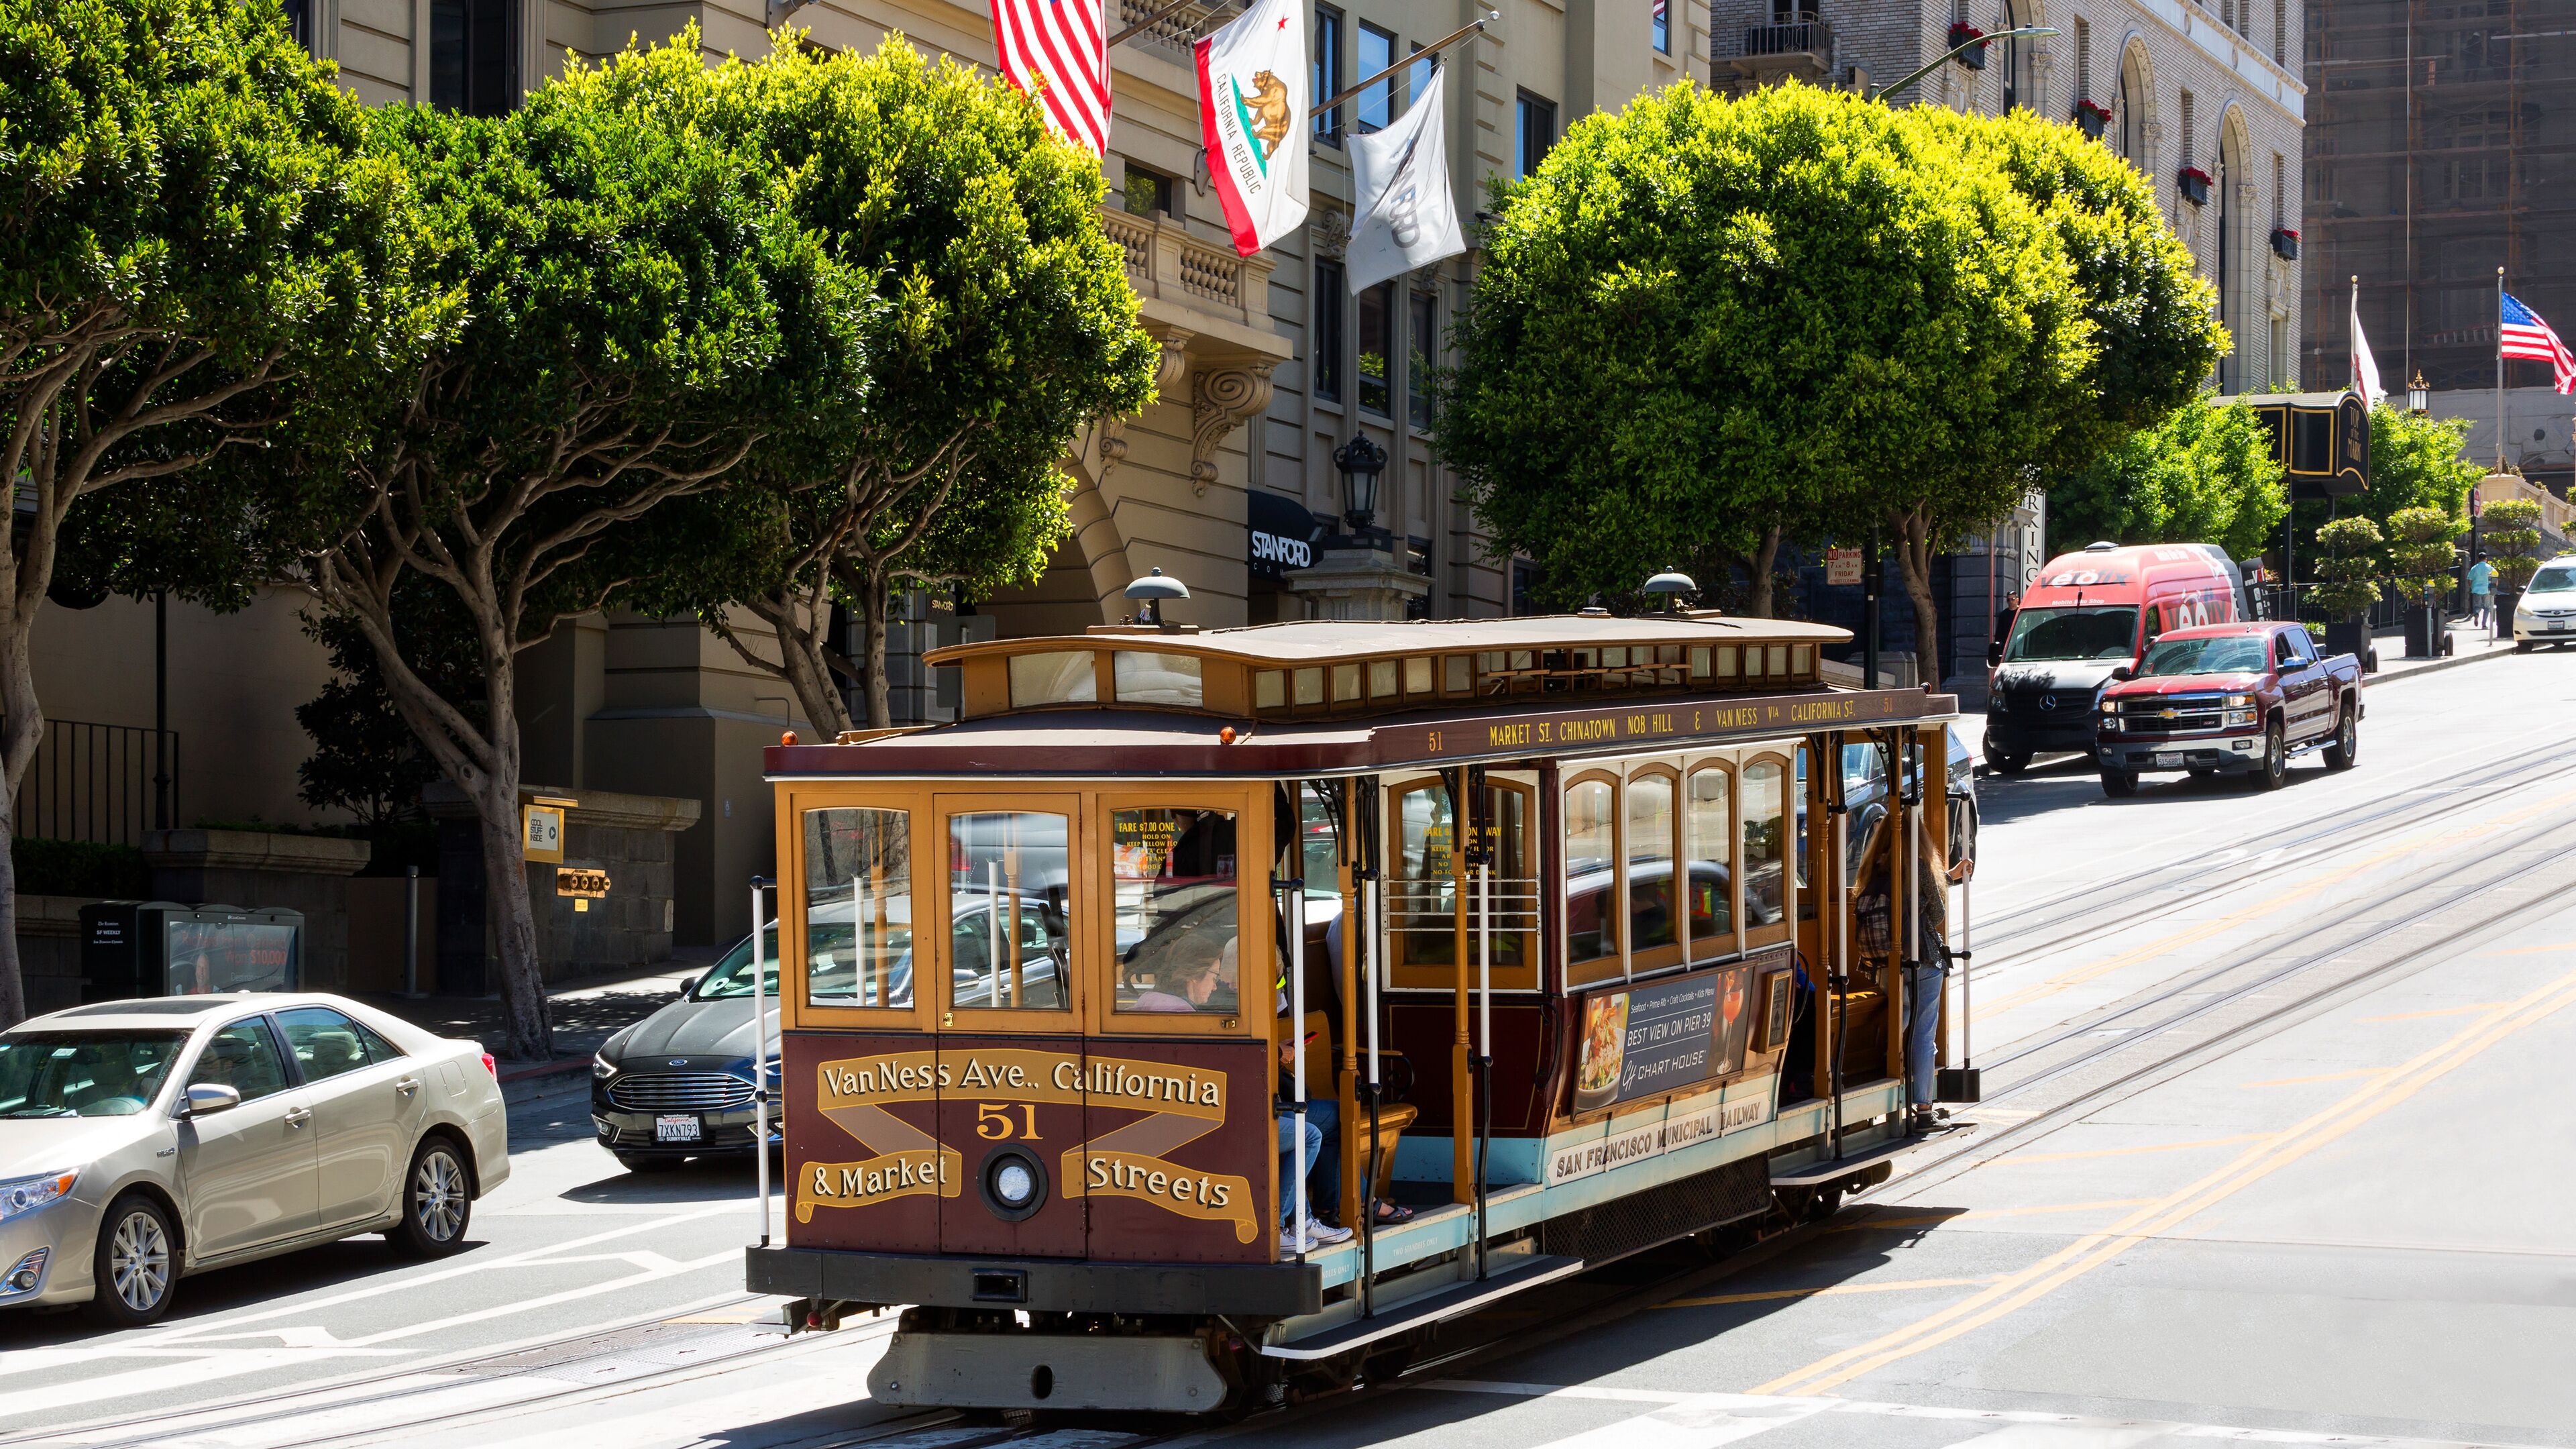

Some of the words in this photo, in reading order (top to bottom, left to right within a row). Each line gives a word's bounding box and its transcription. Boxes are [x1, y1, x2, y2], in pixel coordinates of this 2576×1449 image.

[1217, 73, 1238, 140] CALIFORNIA
[1232, 143, 1261, 195] REPUBLIC
[1252, 530, 1311, 568] STANFORD
[1828, 550, 1837, 559] NO
[1839, 551, 1861, 559] PARKING
[932, 600, 953, 611] STANORD
[1429, 732, 1443, 751] 51
[1489, 724, 1530, 747] MARKET
[1560, 718, 1616, 741] CHINATOWN
[1627, 714, 1646, 735] NOB
[1652, 713, 1673, 733] HILL
[1695, 710, 1701, 731] &
[1716, 710, 1733, 728] VAN
[1735, 707, 1758, 726] NESS
[1791, 702, 1841, 722] CALIFORNIA
[1884, 698, 1892, 713] 51
[531, 818, 543, 826] COOL
[531, 826, 543, 834] STUFF
[1119, 822, 1137, 832] FARE
[1139, 822, 1157, 832] $7.00
[1159, 822, 1175, 832] ONE
[1485, 826, 1502, 837] WAY
[530, 834, 543, 842] INSIDE
[1631, 1002, 1647, 1014] Seafood
[1649, 1000, 1660, 1009] Prime
[1670, 994, 1679, 1005] Craft
[1678, 991, 1695, 1003] Cocktails
[1697, 989, 1705, 998] Kids
[1705, 987, 1715, 996] Menu
[1627, 1027, 1648, 1046] BEST
[1650, 1022, 1670, 1041] VIEW
[1670, 1018, 1682, 1036] ON
[1684, 1014, 1701, 1033] PIER
[1701, 1012, 1711, 1029] 39
[1638, 1059, 1670, 1080] CHART
[1671, 1049, 1705, 1071] HOUSE
[823, 1066, 875, 1097] Van
[877, 1060, 952, 1092] Ness
[1051, 1060, 1221, 1106] California
[659, 1124, 698, 1136] 7XKN793
[975, 1103, 1044, 1141] 51
[1556, 1152, 1582, 1179] SAN
[1587, 1133, 1652, 1170] FRANCISCO
[1657, 1115, 1713, 1149] MUNICIPAL
[812, 1169, 834, 1197] &
[839, 1155, 947, 1199] Market
[1087, 1156, 1232, 1208] Streets
[1393, 1247, 1403, 1256] TWO
[1405, 1240, 1426, 1254] STANDEES
[1426, 1236, 1438, 1246] ONLY
[1338, 1264, 1350, 1275] ONLY
